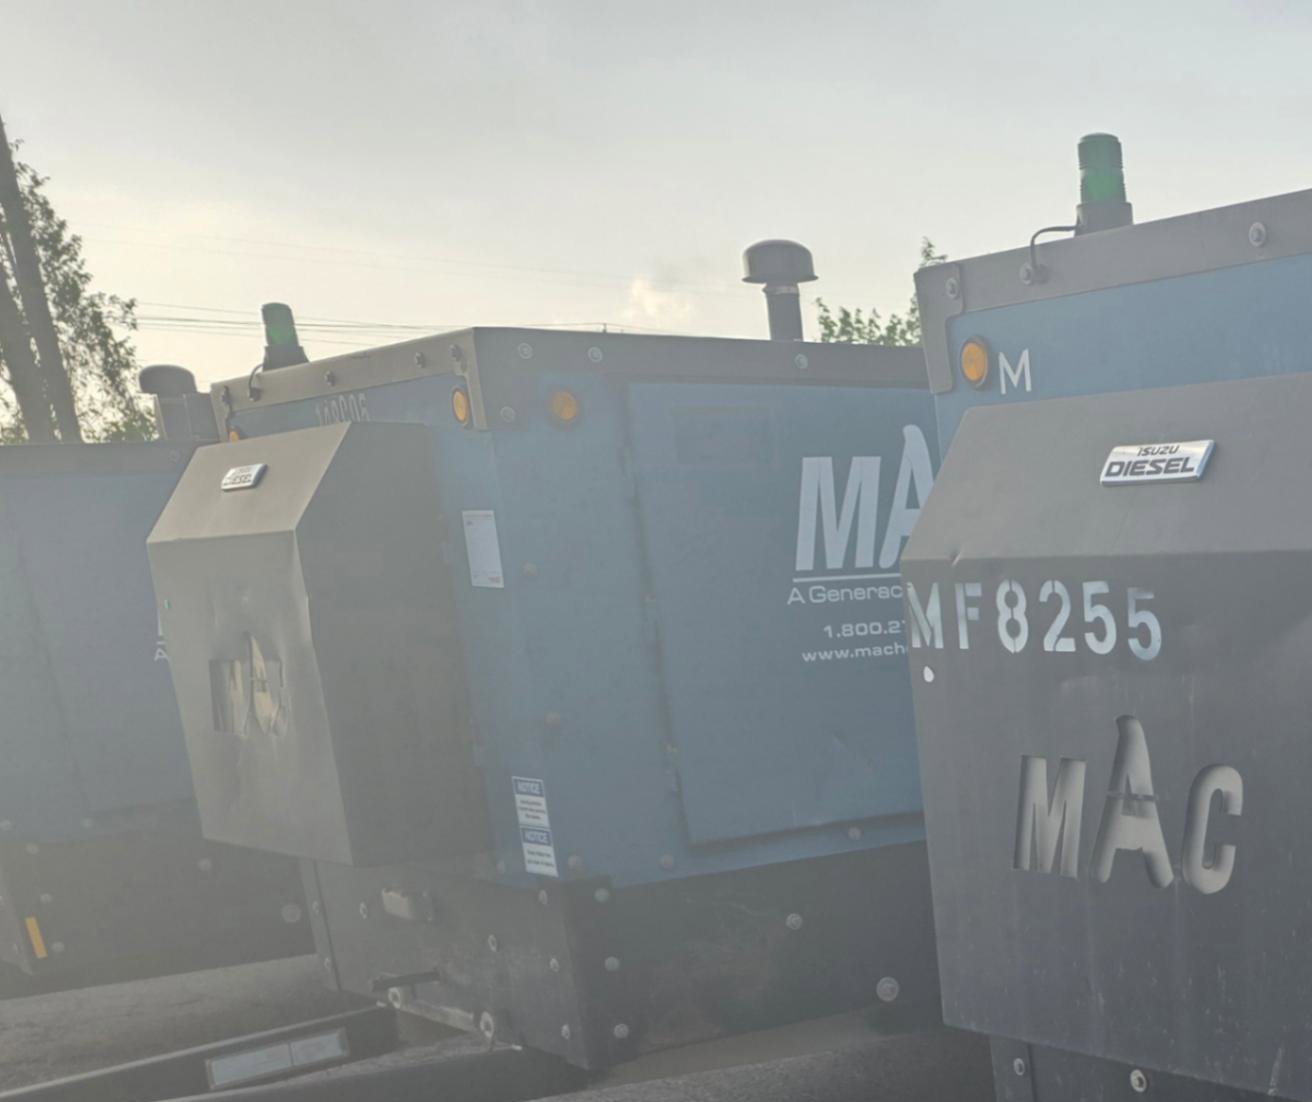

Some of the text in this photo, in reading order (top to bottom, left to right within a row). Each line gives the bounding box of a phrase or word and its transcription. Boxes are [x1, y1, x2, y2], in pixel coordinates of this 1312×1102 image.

[998, 349, 1031, 395] M
[1137, 445, 1180, 456] ISUZU
[1105, 457, 1194, 477] DIESEL
[786, 585, 904, 605] A Generac
[824, 620, 906, 639] 1.800.2
[906, 579, 1163, 661] MF8255
[802, 641, 908, 663] www.mach
[1013, 714, 1244, 895] MAC
